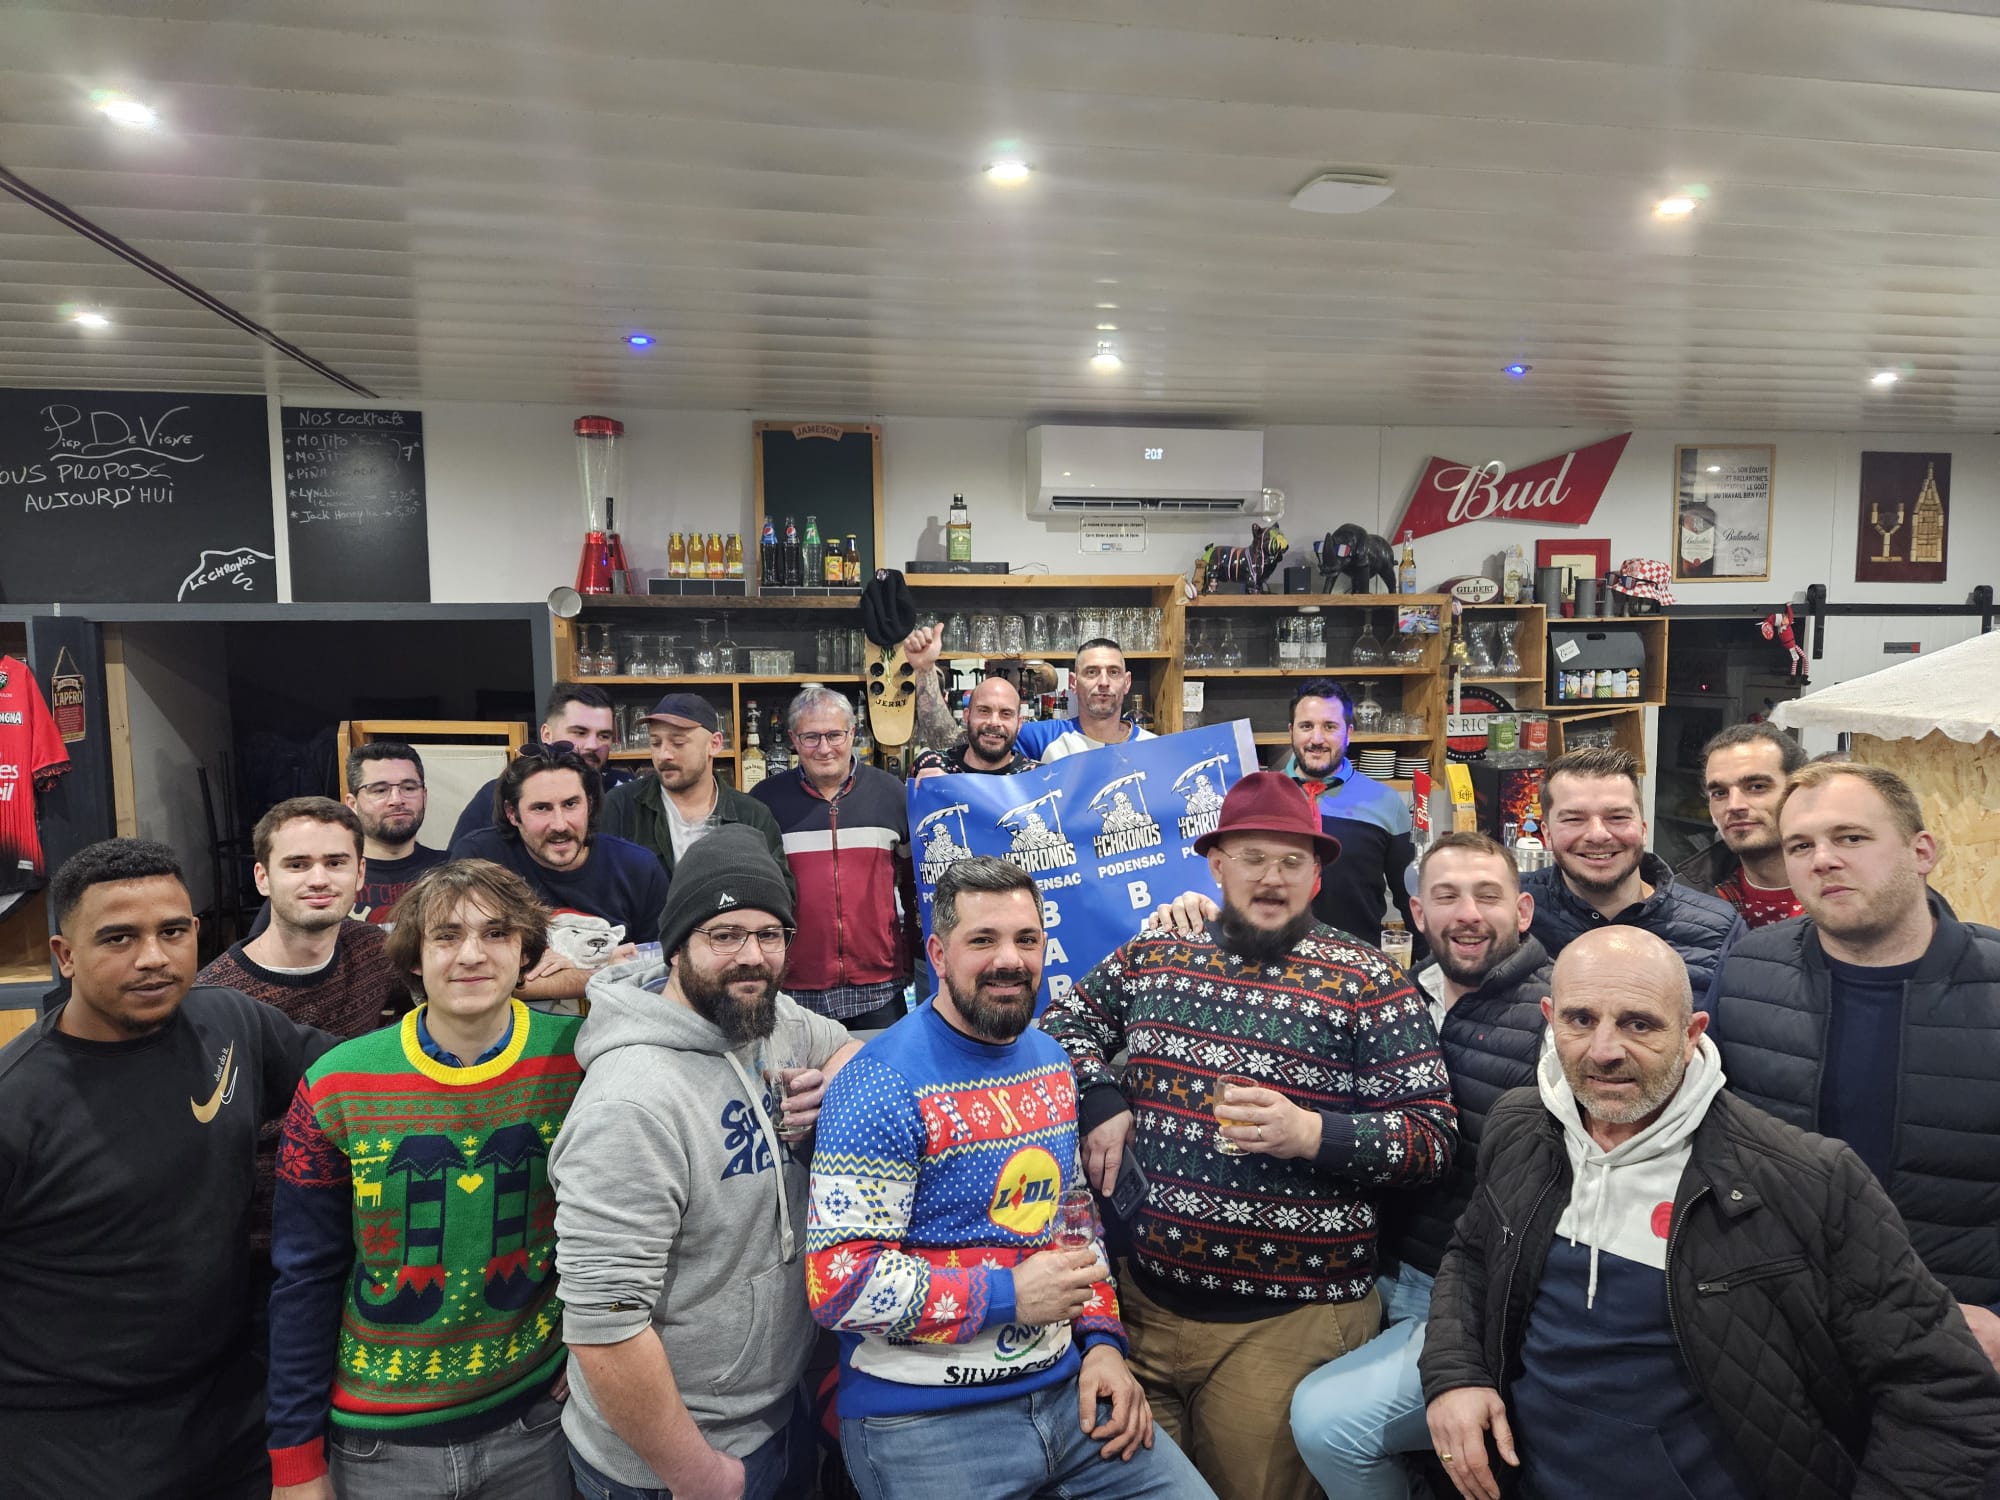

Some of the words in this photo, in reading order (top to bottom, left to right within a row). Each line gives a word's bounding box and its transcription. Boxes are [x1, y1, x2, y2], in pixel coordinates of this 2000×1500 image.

[299, 410, 332, 426] NOS
[796, 424, 839, 437] JAMESON
[0, 465, 47, 484] OUS
[57, 463, 172, 483] PROPOSE
[1433, 452, 1575, 522] Bud
[208, 555, 256, 581] CHRONOS
[1456, 585, 1494, 593] GILBERT
[875, 698, 906, 708] JERRY
[1101, 824, 1161, 857] CHRONOS
[1010, 843, 1077, 873] CHRONOS
[1098, 853, 1166, 878] PODENSAC
[1037, 873, 1082, 891] ENSAC
